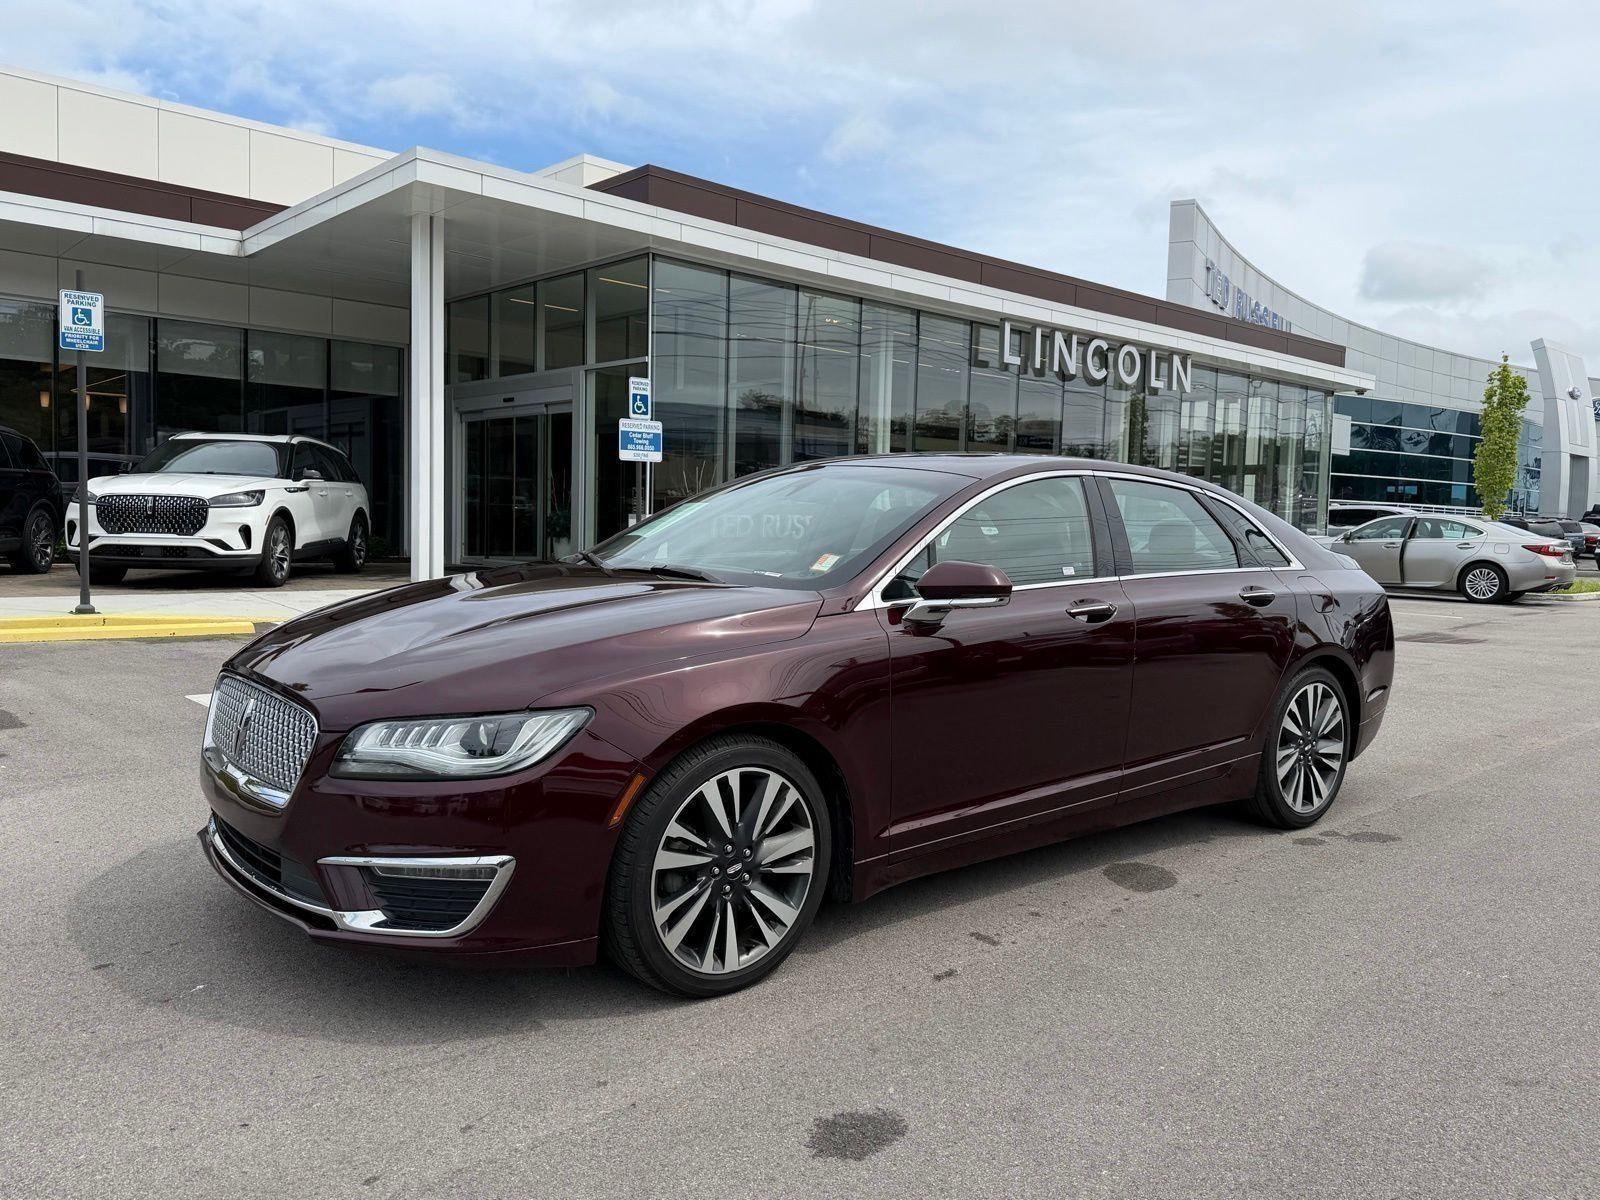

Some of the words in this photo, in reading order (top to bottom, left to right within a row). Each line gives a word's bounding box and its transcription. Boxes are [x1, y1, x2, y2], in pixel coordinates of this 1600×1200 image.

[1206, 257, 1230, 309] TED
[64, 293, 99, 302] RESERVED
[66, 299, 97, 307] PARKING
[1001, 319, 1192, 393] LINCOLN
[622, 422, 643, 430] RESERVED
